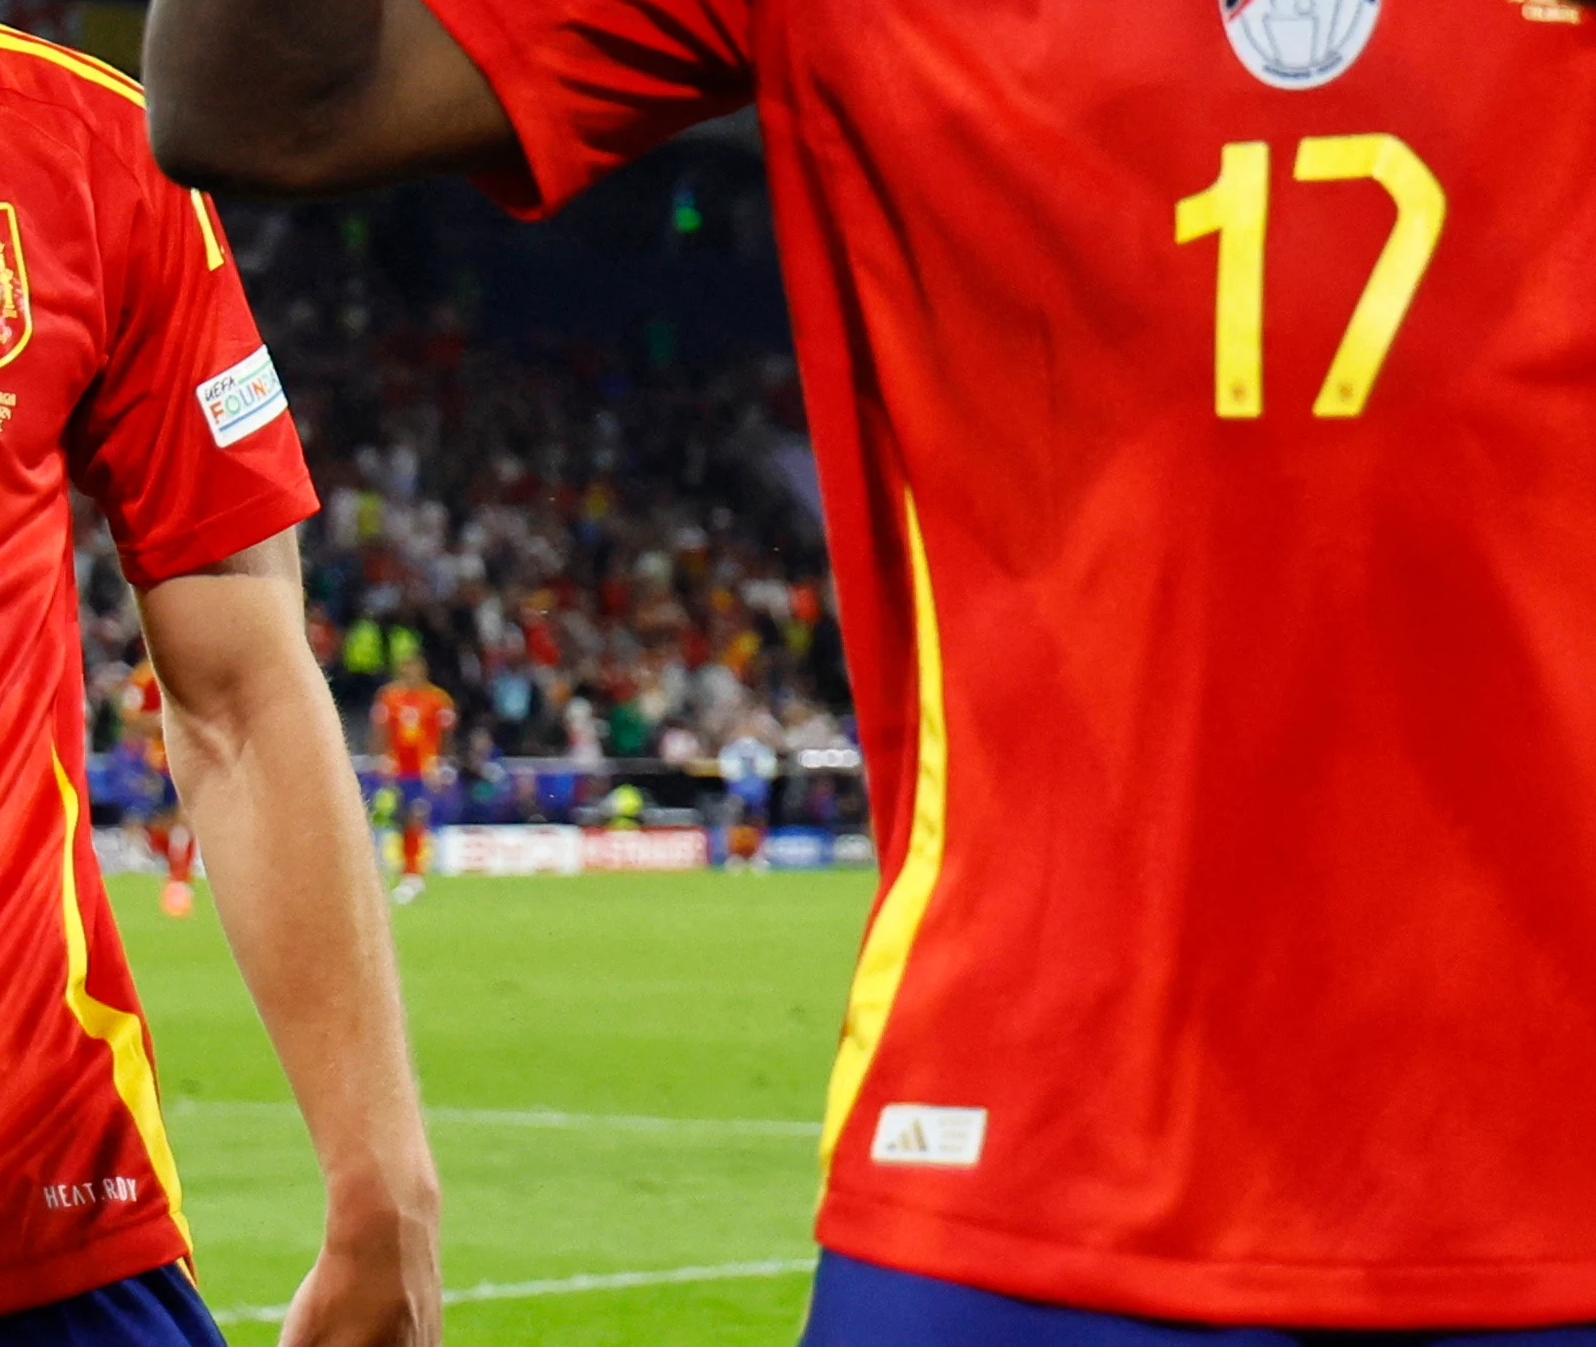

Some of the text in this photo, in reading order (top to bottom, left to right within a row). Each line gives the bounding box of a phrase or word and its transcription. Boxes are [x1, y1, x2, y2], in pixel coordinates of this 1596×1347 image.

[1174, 132, 1447, 419] 17
[205, 376, 235, 401] UEFA
[44, 1176, 137, 1208] HEAT.RDY
